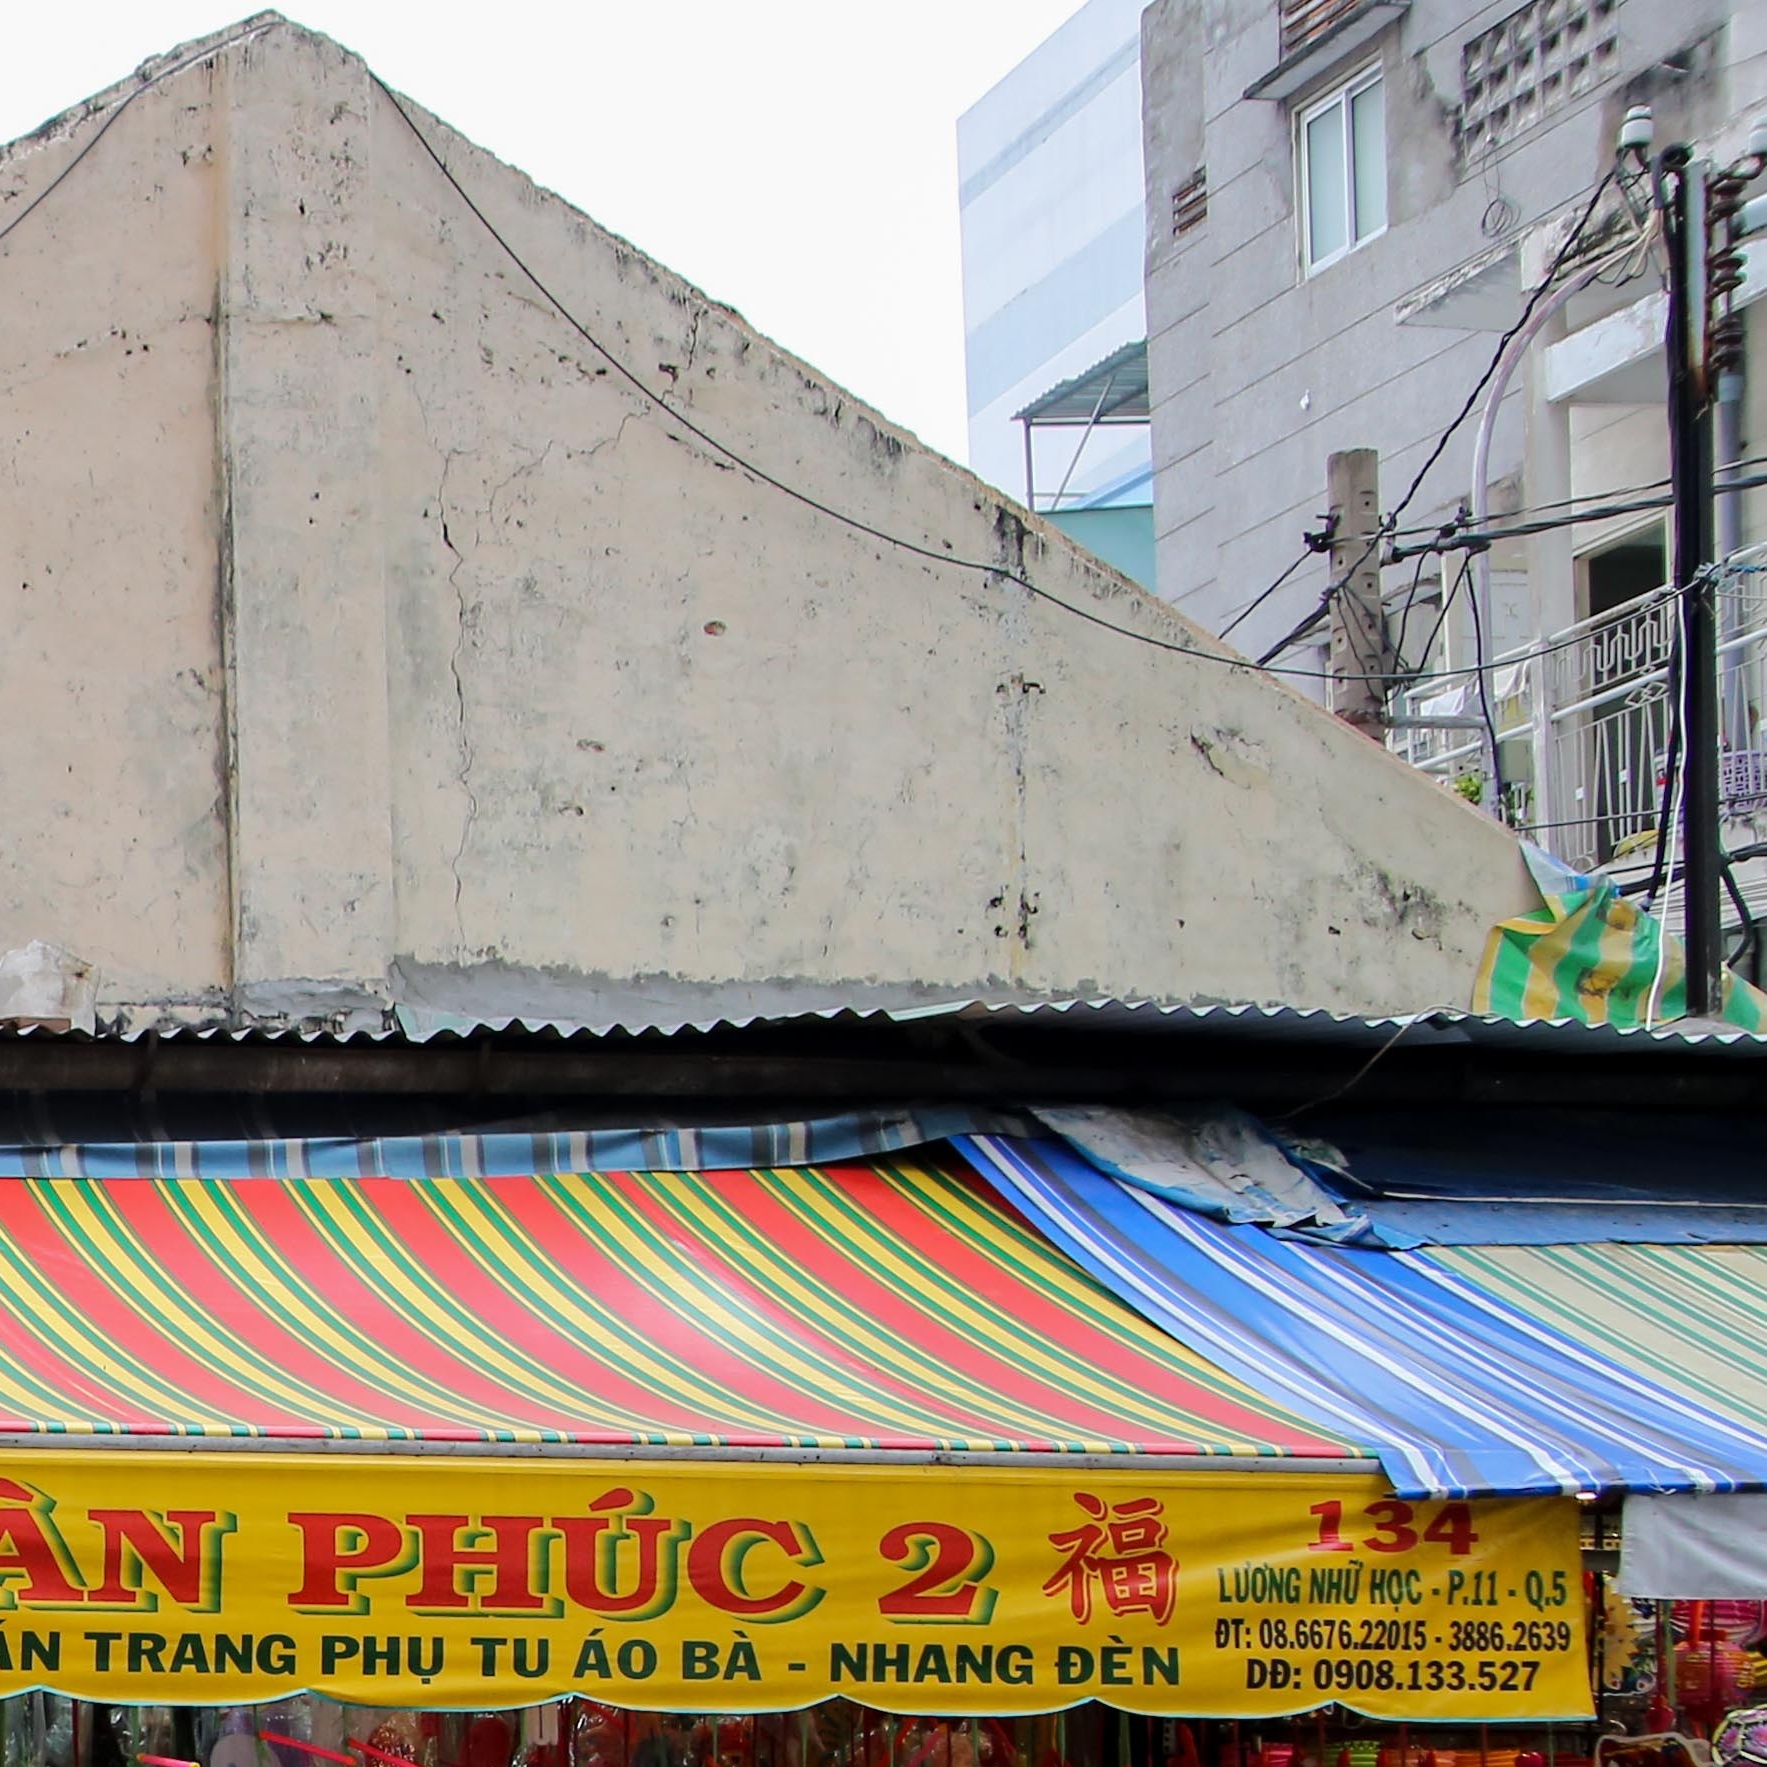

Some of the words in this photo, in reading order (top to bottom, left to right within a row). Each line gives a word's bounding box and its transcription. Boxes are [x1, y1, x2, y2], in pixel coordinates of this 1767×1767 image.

[1306, 1500, 1479, 1555] 134
[286, 1487, 827, 1623] PHÚC
[877, 1521, 999, 1624] 2
[1043, 1491, 1180, 1626] 福
[1369, 1568, 1423, 1612] HỌC
[1447, 1569, 1498, 1606] P.11
[1525, 1570, 1567, 1612] Q.5
[84, 1632, 297, 1676] TRANG
[321, 1637, 445, 1683] PHỤ
[471, 1637, 550, 1679] TU
[573, 1628, 658, 1680] ÁO
[681, 1630, 764, 1682] BÀ
[829, 1641, 1035, 1686] NHANG
[1055, 1634, 1181, 1686] ĐÈN
[1215, 1617, 1252, 1649] ĐT:
[1259, 1618, 1427, 1651] 08.6676.22015
[1449, 1620, 1571, 1652] 3886.2639
[1246, 1658, 1302, 1690] DĐ:
[1313, 1659, 1541, 1691] 0908.133.527
